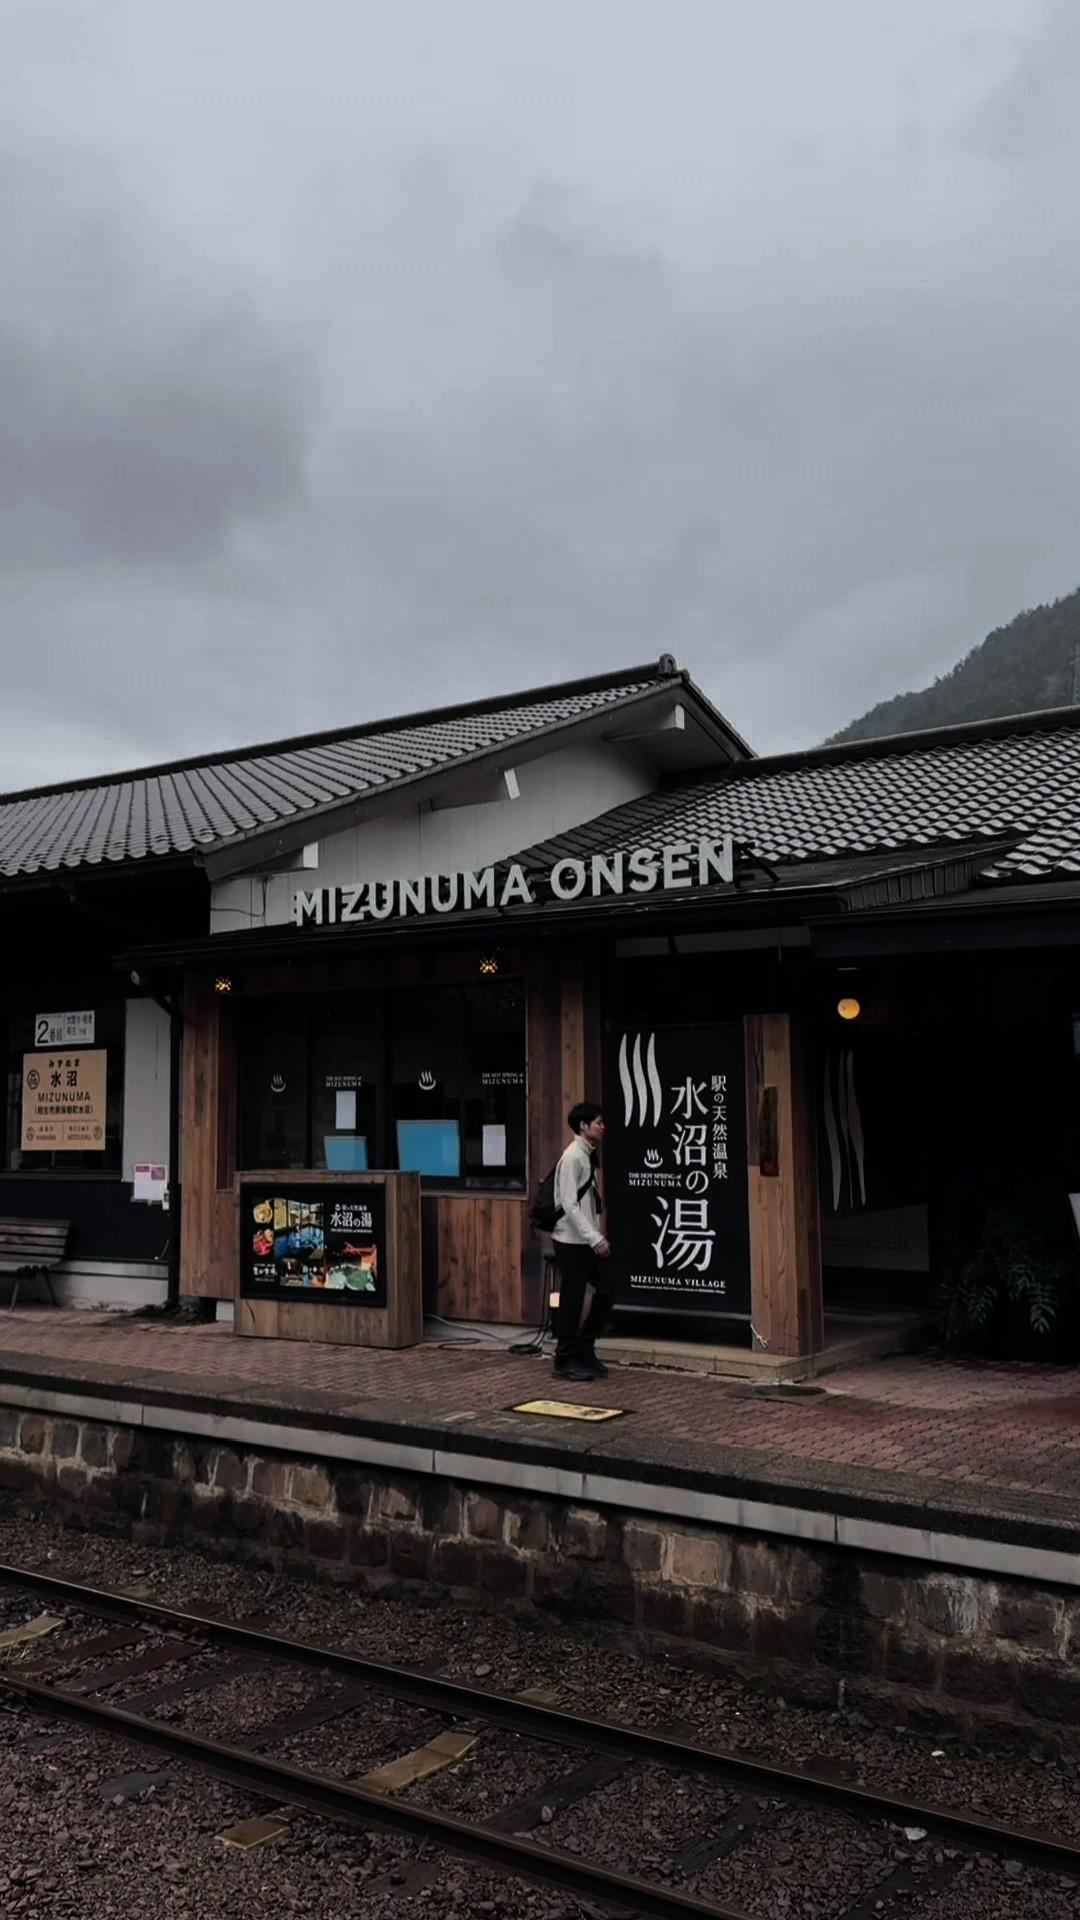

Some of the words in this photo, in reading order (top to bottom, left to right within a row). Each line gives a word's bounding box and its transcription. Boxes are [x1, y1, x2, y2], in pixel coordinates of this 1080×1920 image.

[295, 863, 534, 927] MIZUNUMA
[550, 837, 735, 900] ONSEN
[48, 1058, 80, 1069] みずぬま
[50, 1070, 78, 1088] 水沼
[37, 1091, 91, 1103] MIZUNUMA
[711, 1075, 728, 1179] 駅の天然温泉
[628, 1172, 640, 1180] THE
[641, 1172, 653, 1180] HOT
[654, 1172, 675, 1180] SPRING
[650, 1076, 716, 1272] 水沼の湯
[628, 1179, 682, 1188] MIZUNUMA
[329, 1211, 373, 1228] 水沼の湯
[630, 1275, 682, 1286] MIZUNUMA
[684, 1278, 727, 1289] VILLAGE
